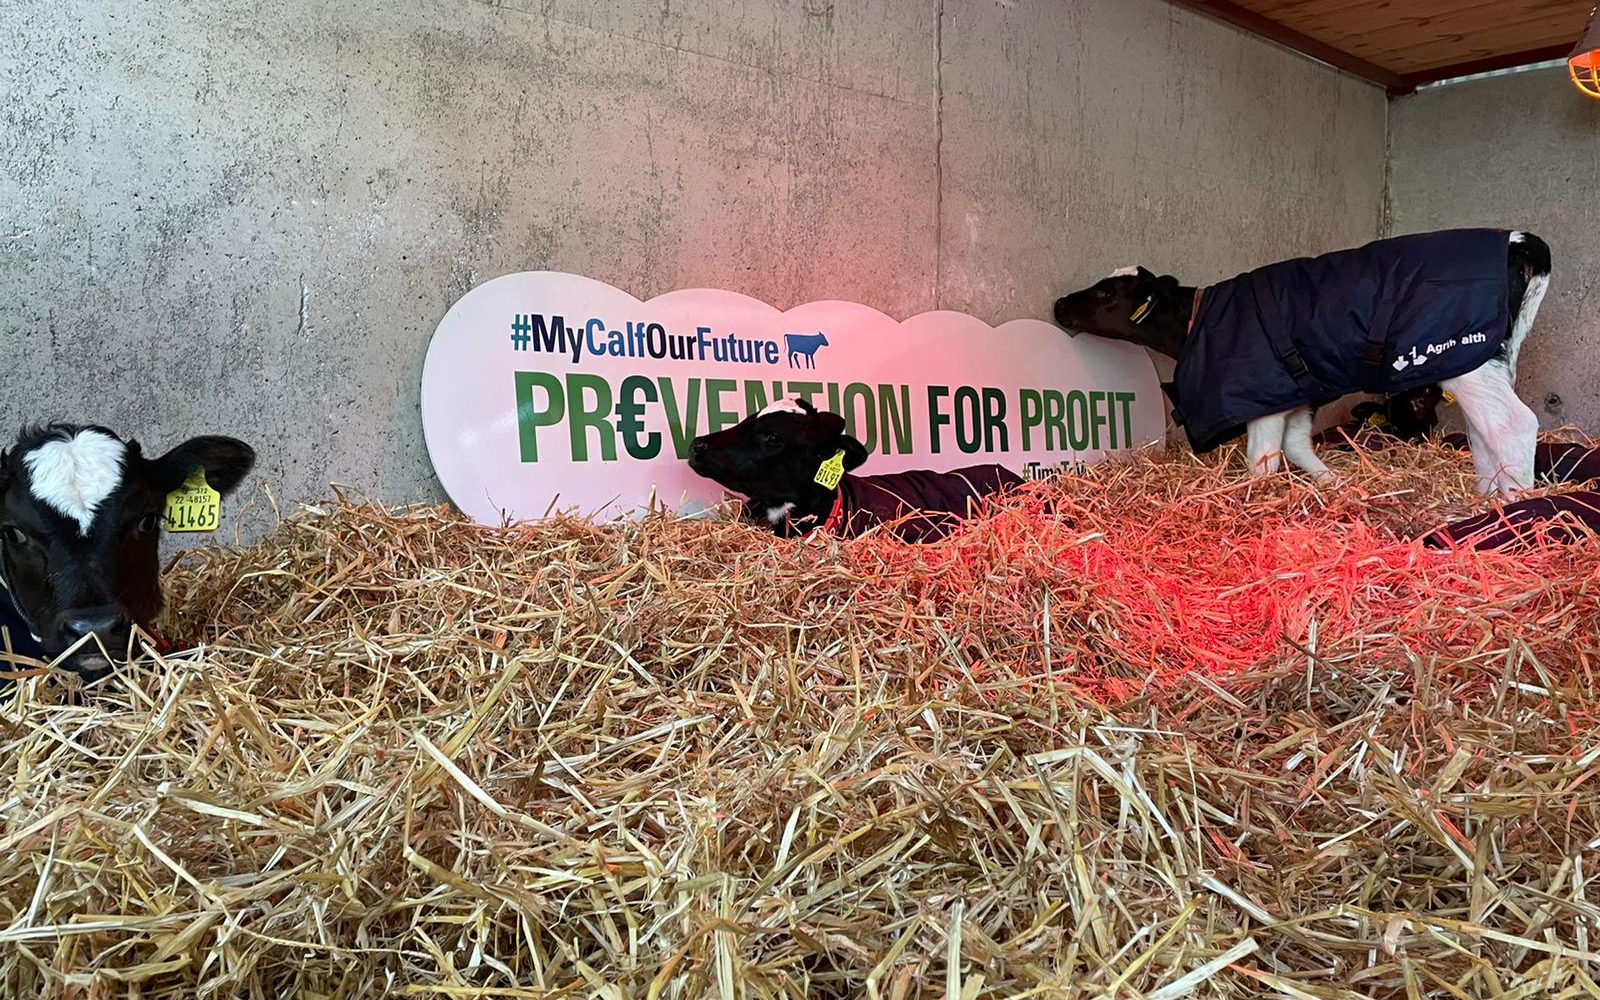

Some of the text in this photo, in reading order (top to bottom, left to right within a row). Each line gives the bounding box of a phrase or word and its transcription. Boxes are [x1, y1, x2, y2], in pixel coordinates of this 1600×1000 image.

[510, 314, 779, 364] #MyCalfOurFuture
[927, 385, 1009, 454] FOR
[1019, 388, 1136, 452] PROFIT
[167, 504, 216, 528] 41465
